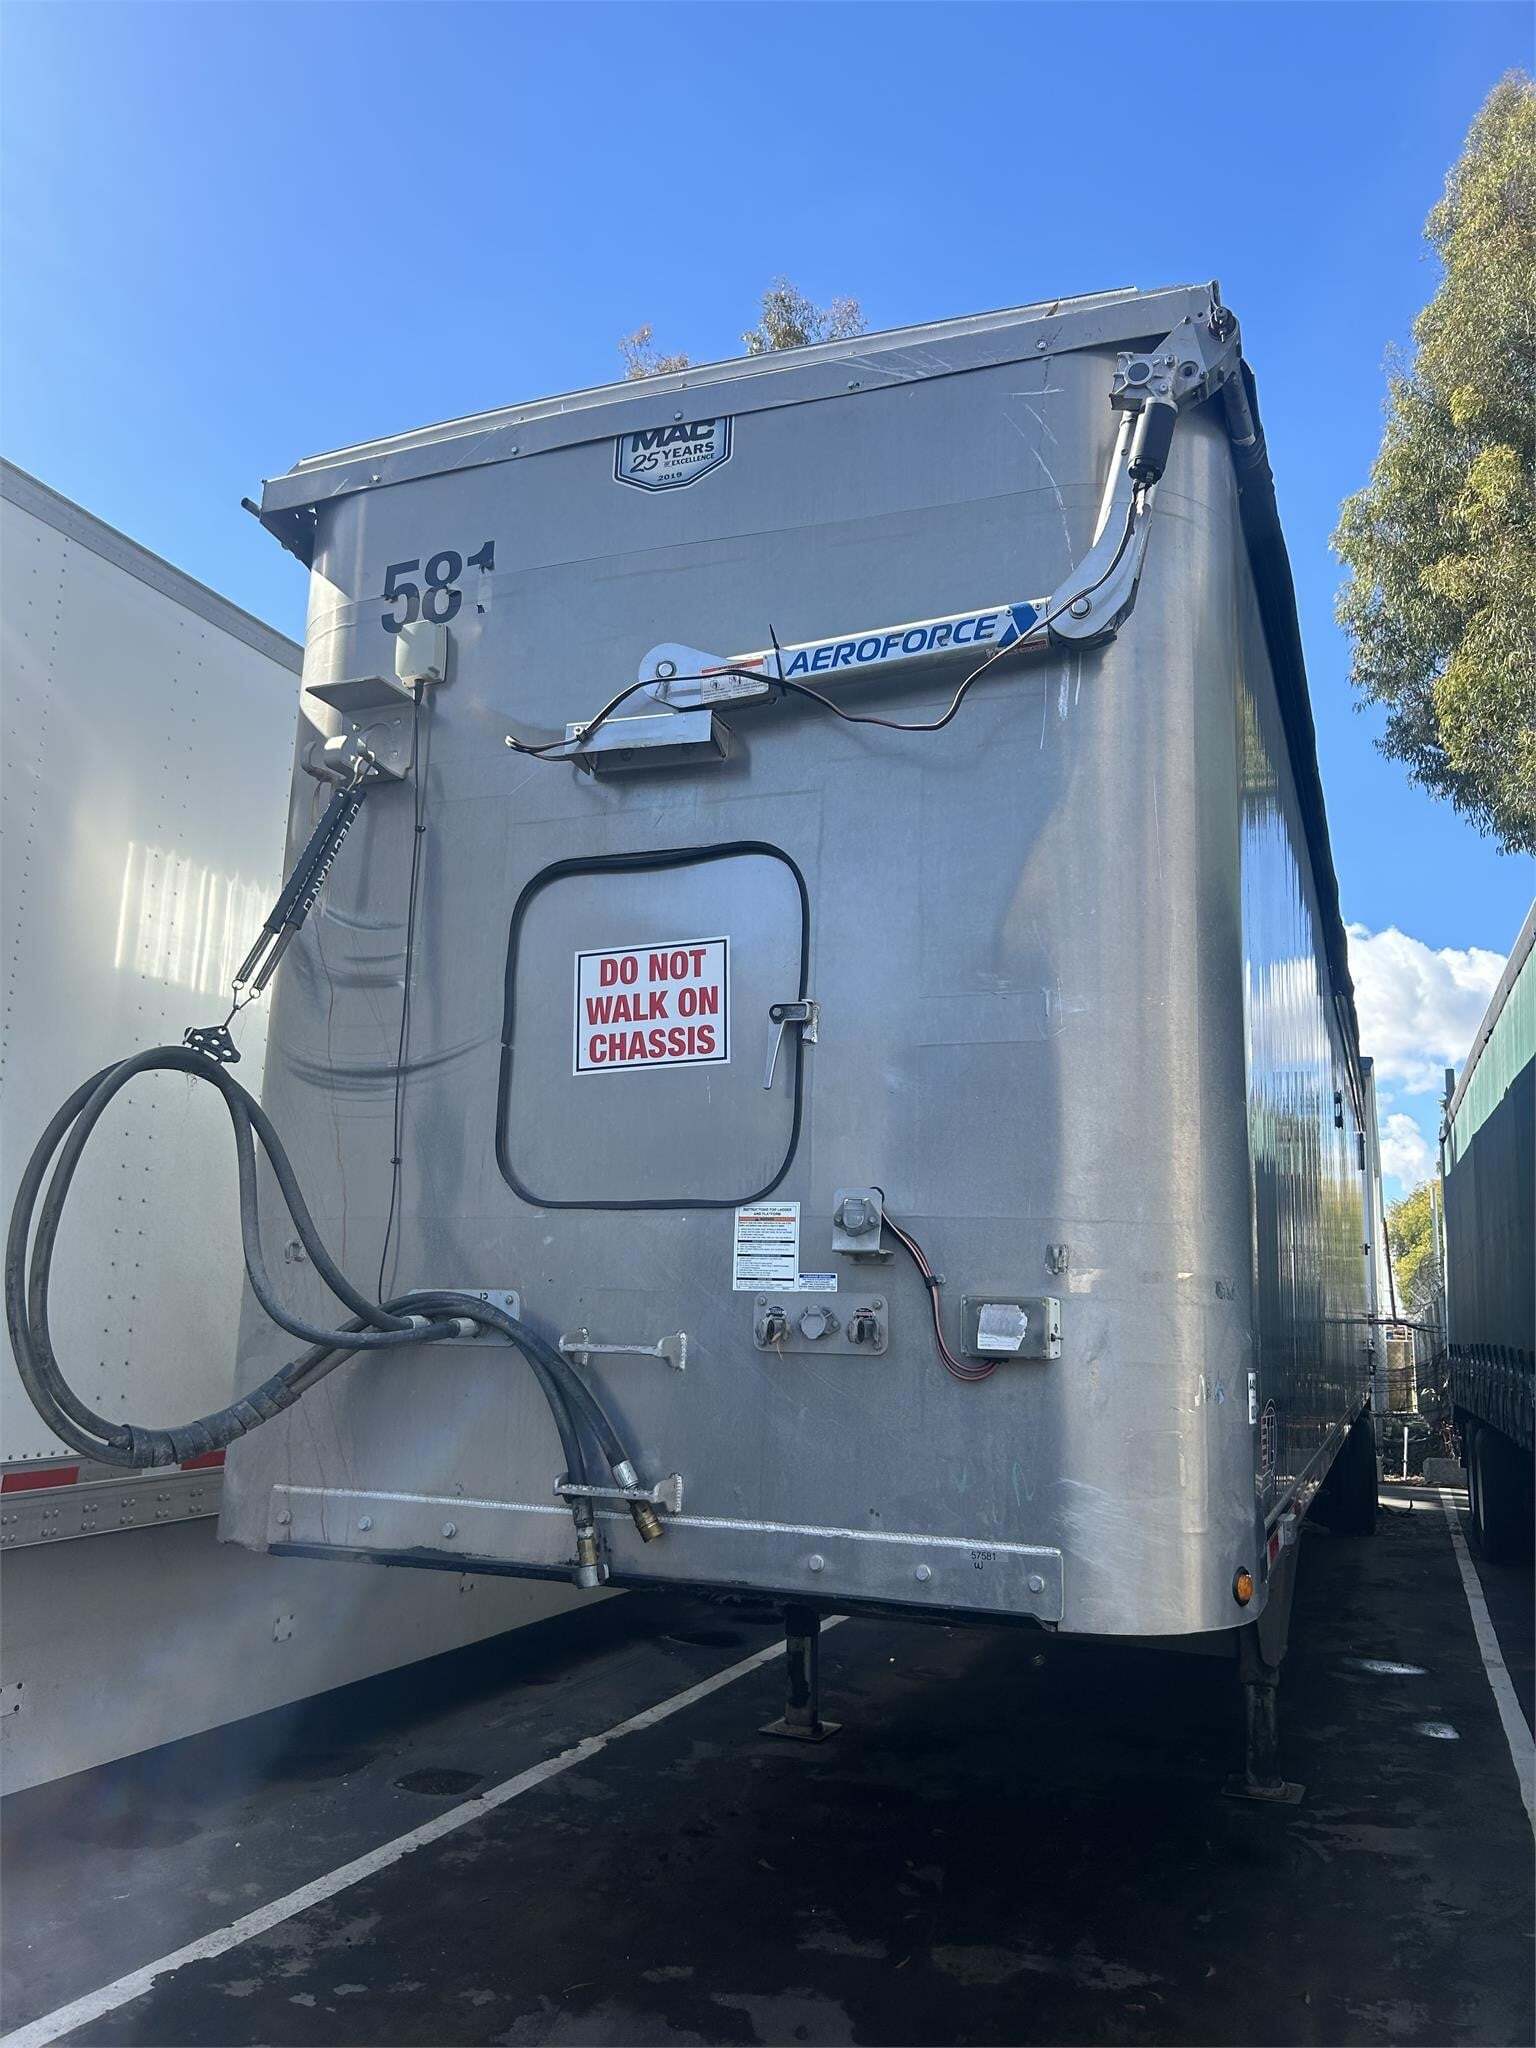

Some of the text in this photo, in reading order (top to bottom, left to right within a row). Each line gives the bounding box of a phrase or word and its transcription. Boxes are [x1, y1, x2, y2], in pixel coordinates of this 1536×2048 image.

[631, 419, 716, 452] MAC
[630, 441, 715, 473] 25 YEARS
[671, 452, 715, 466] EXCELLENCE
[785, 614, 999, 677] AEROFORCE
[600, 949, 707, 987] DO NOT
[585, 986, 719, 1025] WALK ON
[588, 1024, 716, 1063] CHASSIS
[971, 1551, 996, 1561] 57581
